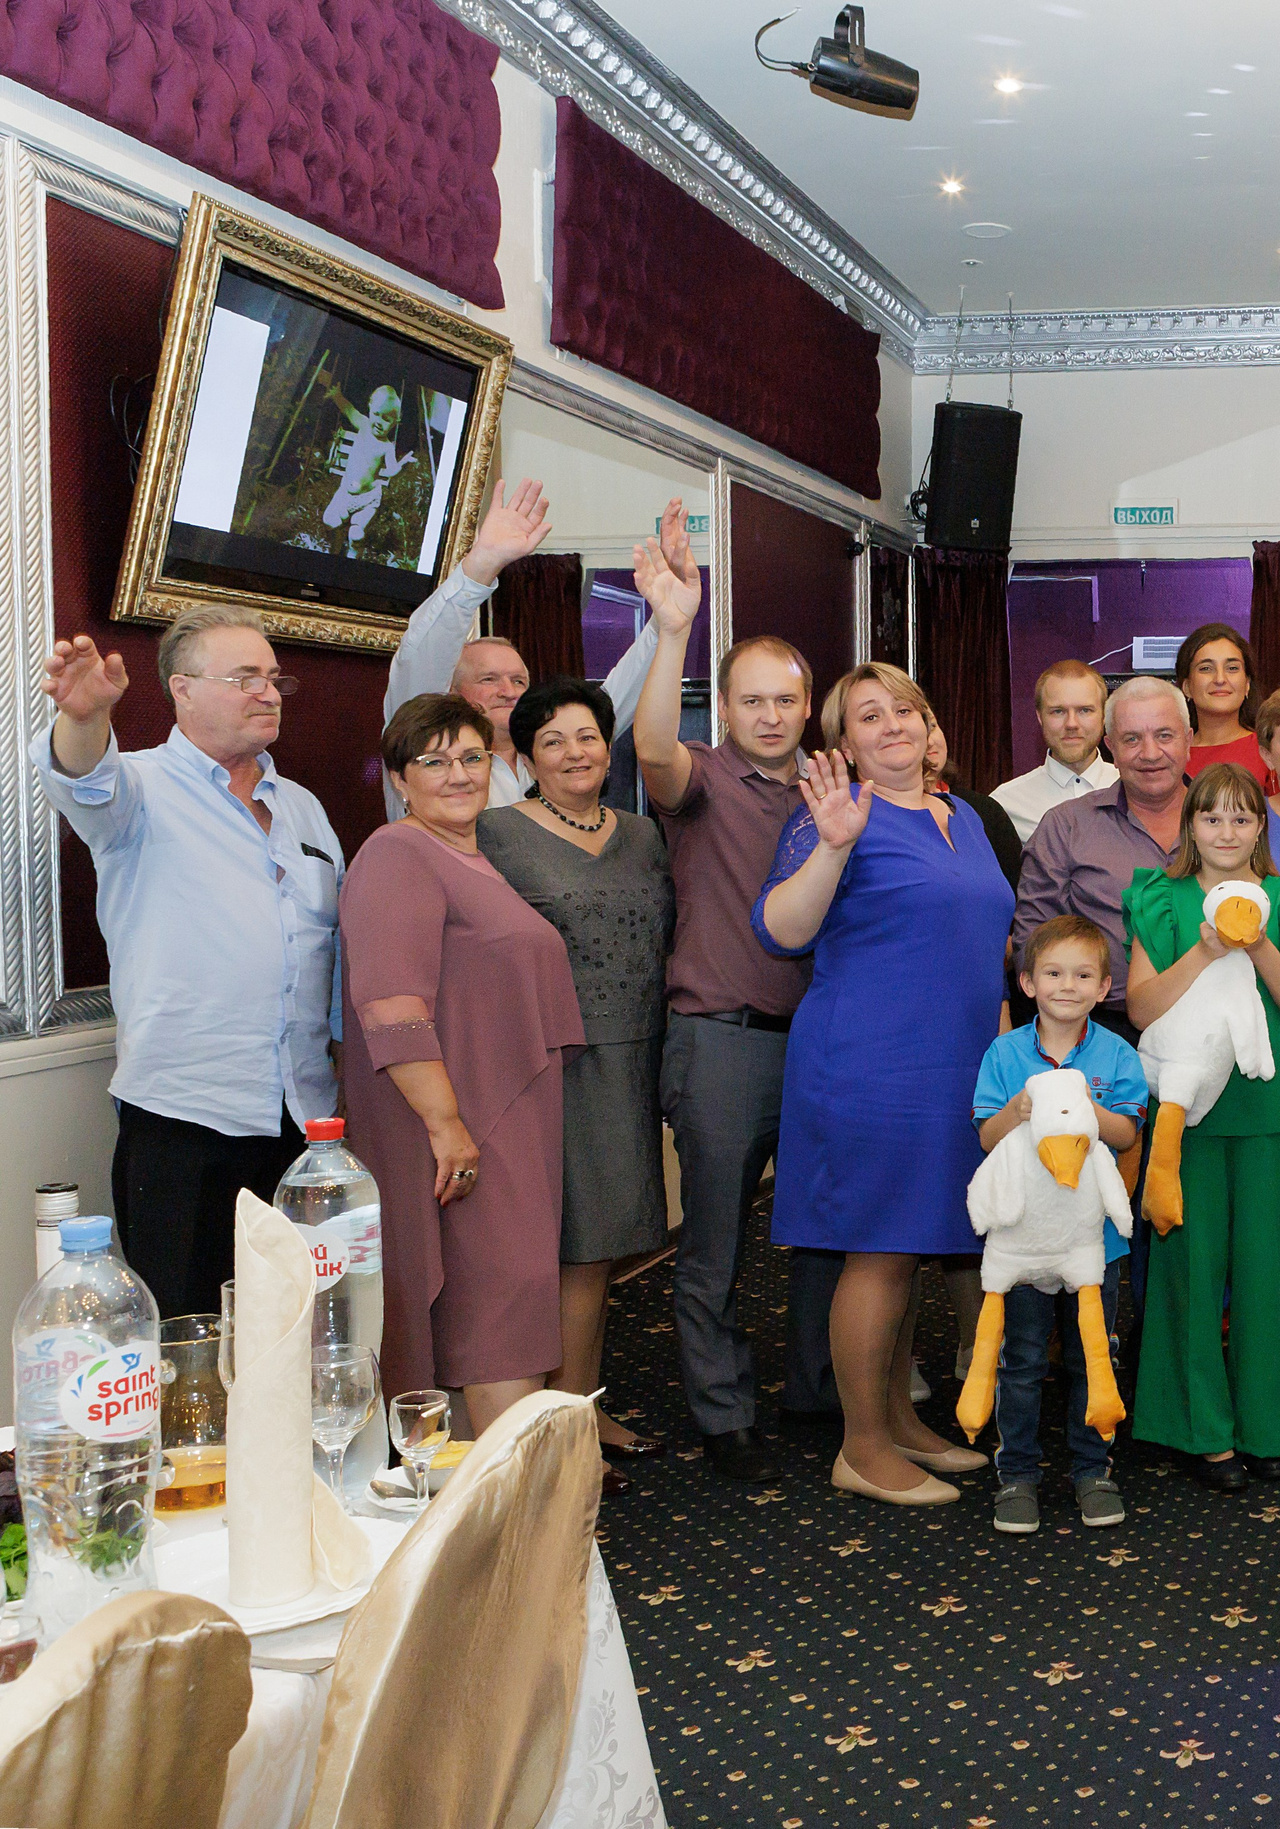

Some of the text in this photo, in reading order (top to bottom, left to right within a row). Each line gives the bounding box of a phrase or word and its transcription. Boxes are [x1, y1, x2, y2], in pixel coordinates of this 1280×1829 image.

[1117, 510, 1172, 525] ВЫХОД
[97, 1364, 156, 1399] saint
[87, 1386, 160, 1427] spring
